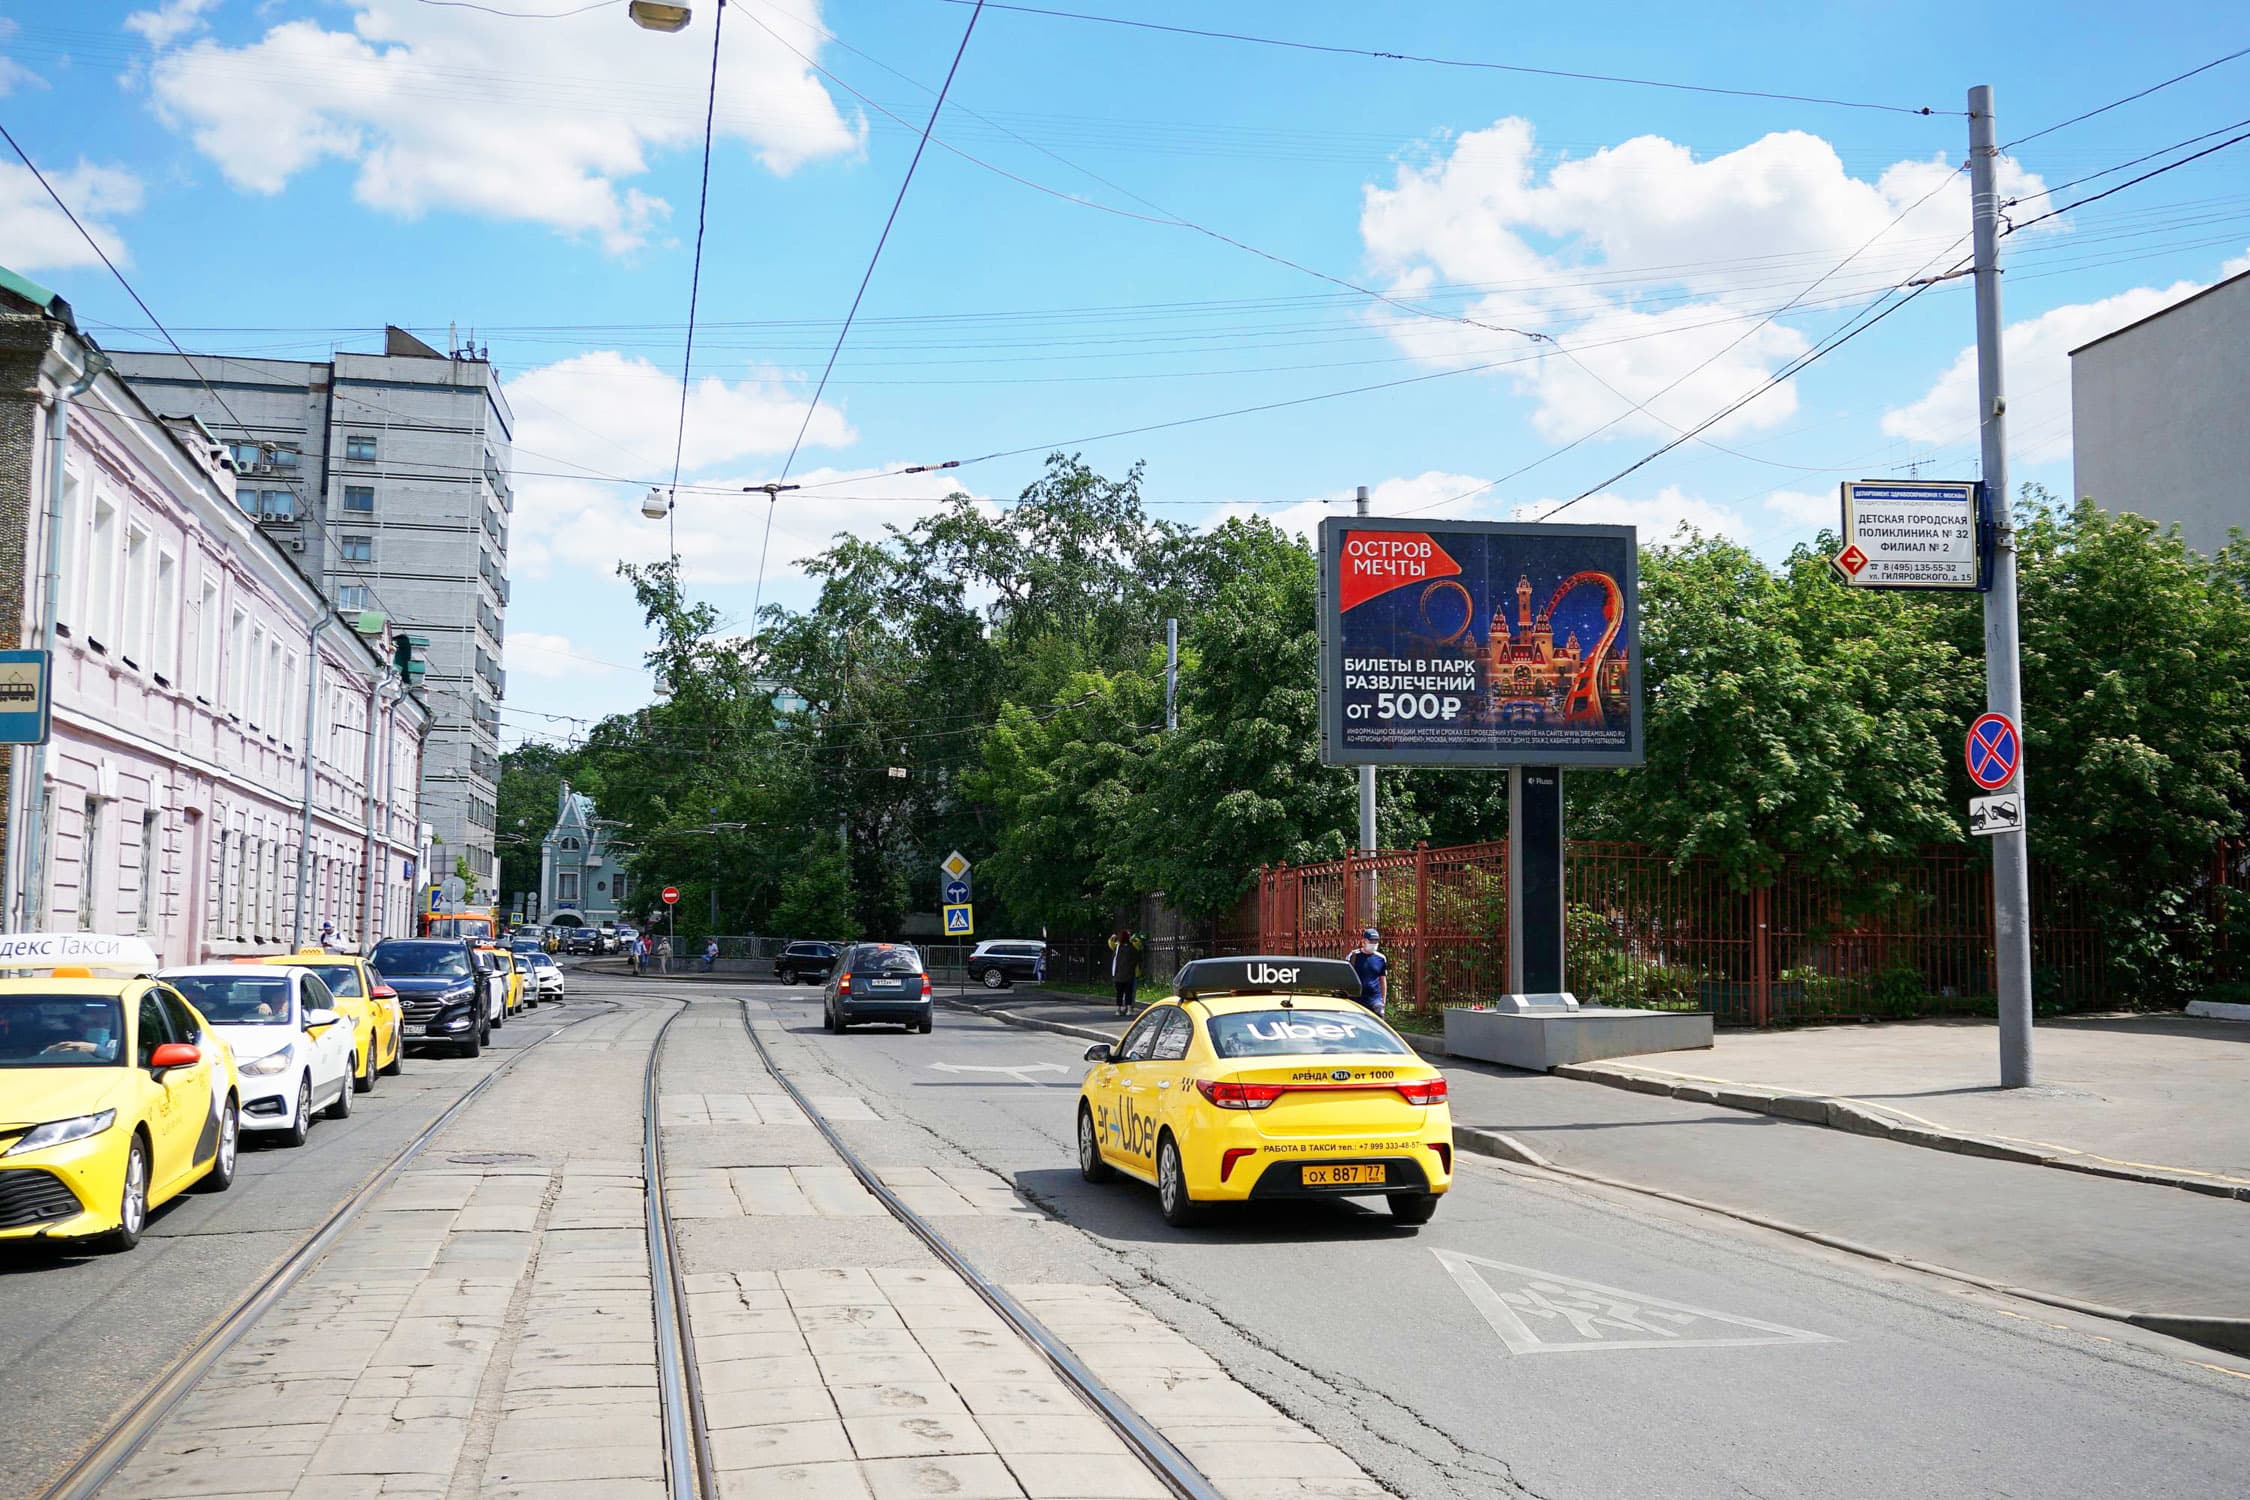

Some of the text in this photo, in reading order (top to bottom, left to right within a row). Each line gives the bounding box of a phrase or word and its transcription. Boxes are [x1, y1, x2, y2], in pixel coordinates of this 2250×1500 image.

[1859, 514, 1968, 525] ДЕТСКАЯ ГОРОДСКАЯ
[1859, 528, 1969, 539] ПОЛИКЛИНИКА № 32
[1348, 540, 1432, 559] ОСТРОВ
[1880, 542, 1950, 552] ФИЛИАЛ № 2
[1353, 559, 1426, 577] МЕЧТЫ
[1883, 563, 1956, 572] 8 (495) 135-55-32
[1882, 573, 1950, 581] ГИЛЯРОВСКОГО,
[1345, 658, 1476, 673] БИЛЕТЫ В ПАРК
[1345, 673, 1476, 691] РАЗВЛЕЧЕНИЙ
[60, 936, 120, 955] Такси
[1247, 963, 1301, 984] Uber
[1246, 1021, 1358, 1041] Uber
[1292, 1072, 1328, 1081] АРЕНДА
[1333, 1072, 1350, 1080] KIA
[1370, 1071, 1394, 1079] 1000
[1264, 1145, 1298, 1153] РАБОТА
[1301, 1144, 1306, 1152] В
[1309, 1144, 1337, 1152] ТАКСИ
[1332, 1167, 1359, 1181] 887
[1367, 1165, 1381, 1177] 77
